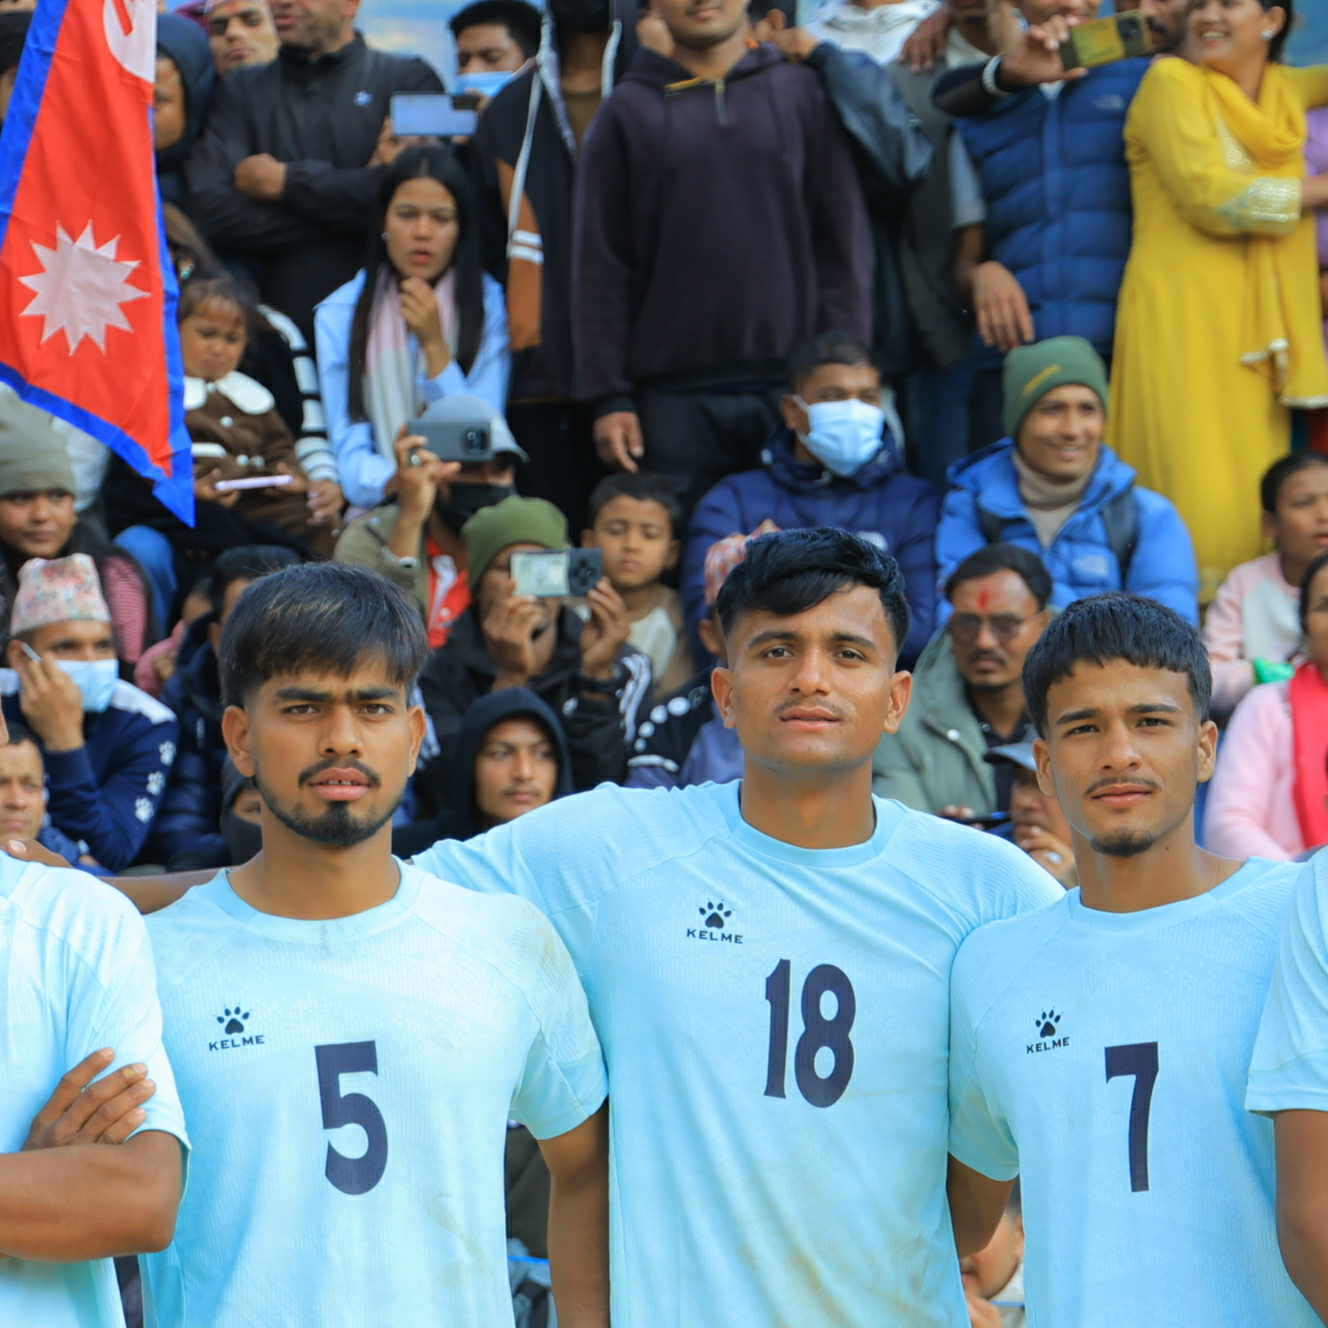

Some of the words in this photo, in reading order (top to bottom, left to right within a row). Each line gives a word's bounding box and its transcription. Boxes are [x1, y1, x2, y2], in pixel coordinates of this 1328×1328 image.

[685, 928, 744, 945] KELME
[208, 1034, 266, 1052] KELME
[763, 958, 856, 1109] 18
[1026, 1036, 1071, 1055] KELME
[314, 1040, 388, 1195] 5
[1104, 1041, 1160, 1193] 7
